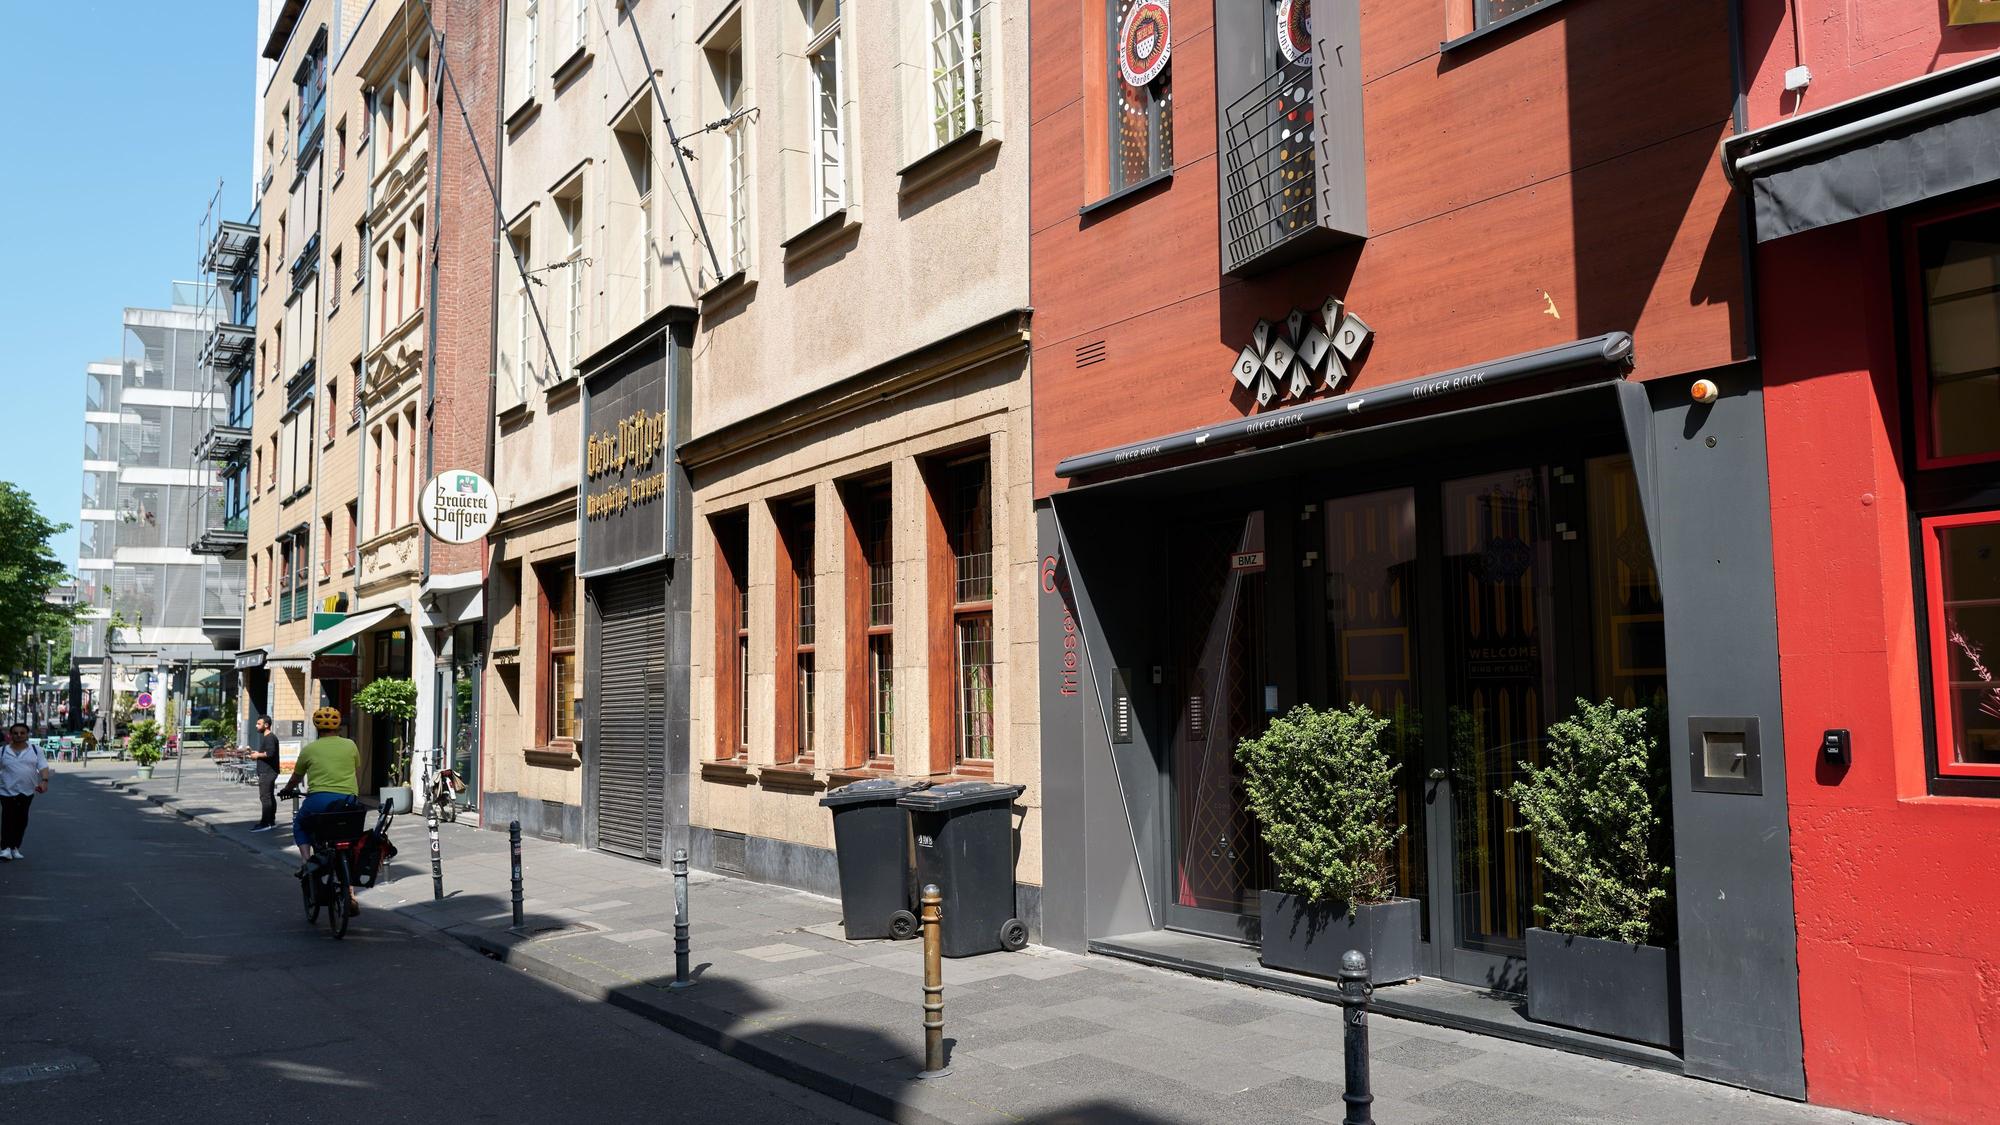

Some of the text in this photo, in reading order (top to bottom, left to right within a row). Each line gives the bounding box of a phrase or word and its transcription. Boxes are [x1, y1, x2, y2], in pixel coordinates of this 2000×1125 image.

[1241, 330, 1356, 375] GRID
[433, 507, 488, 541] Päffgen
[1238, 554, 1257, 566] BMZ
[1469, 647, 1537, 658] WELCOME
